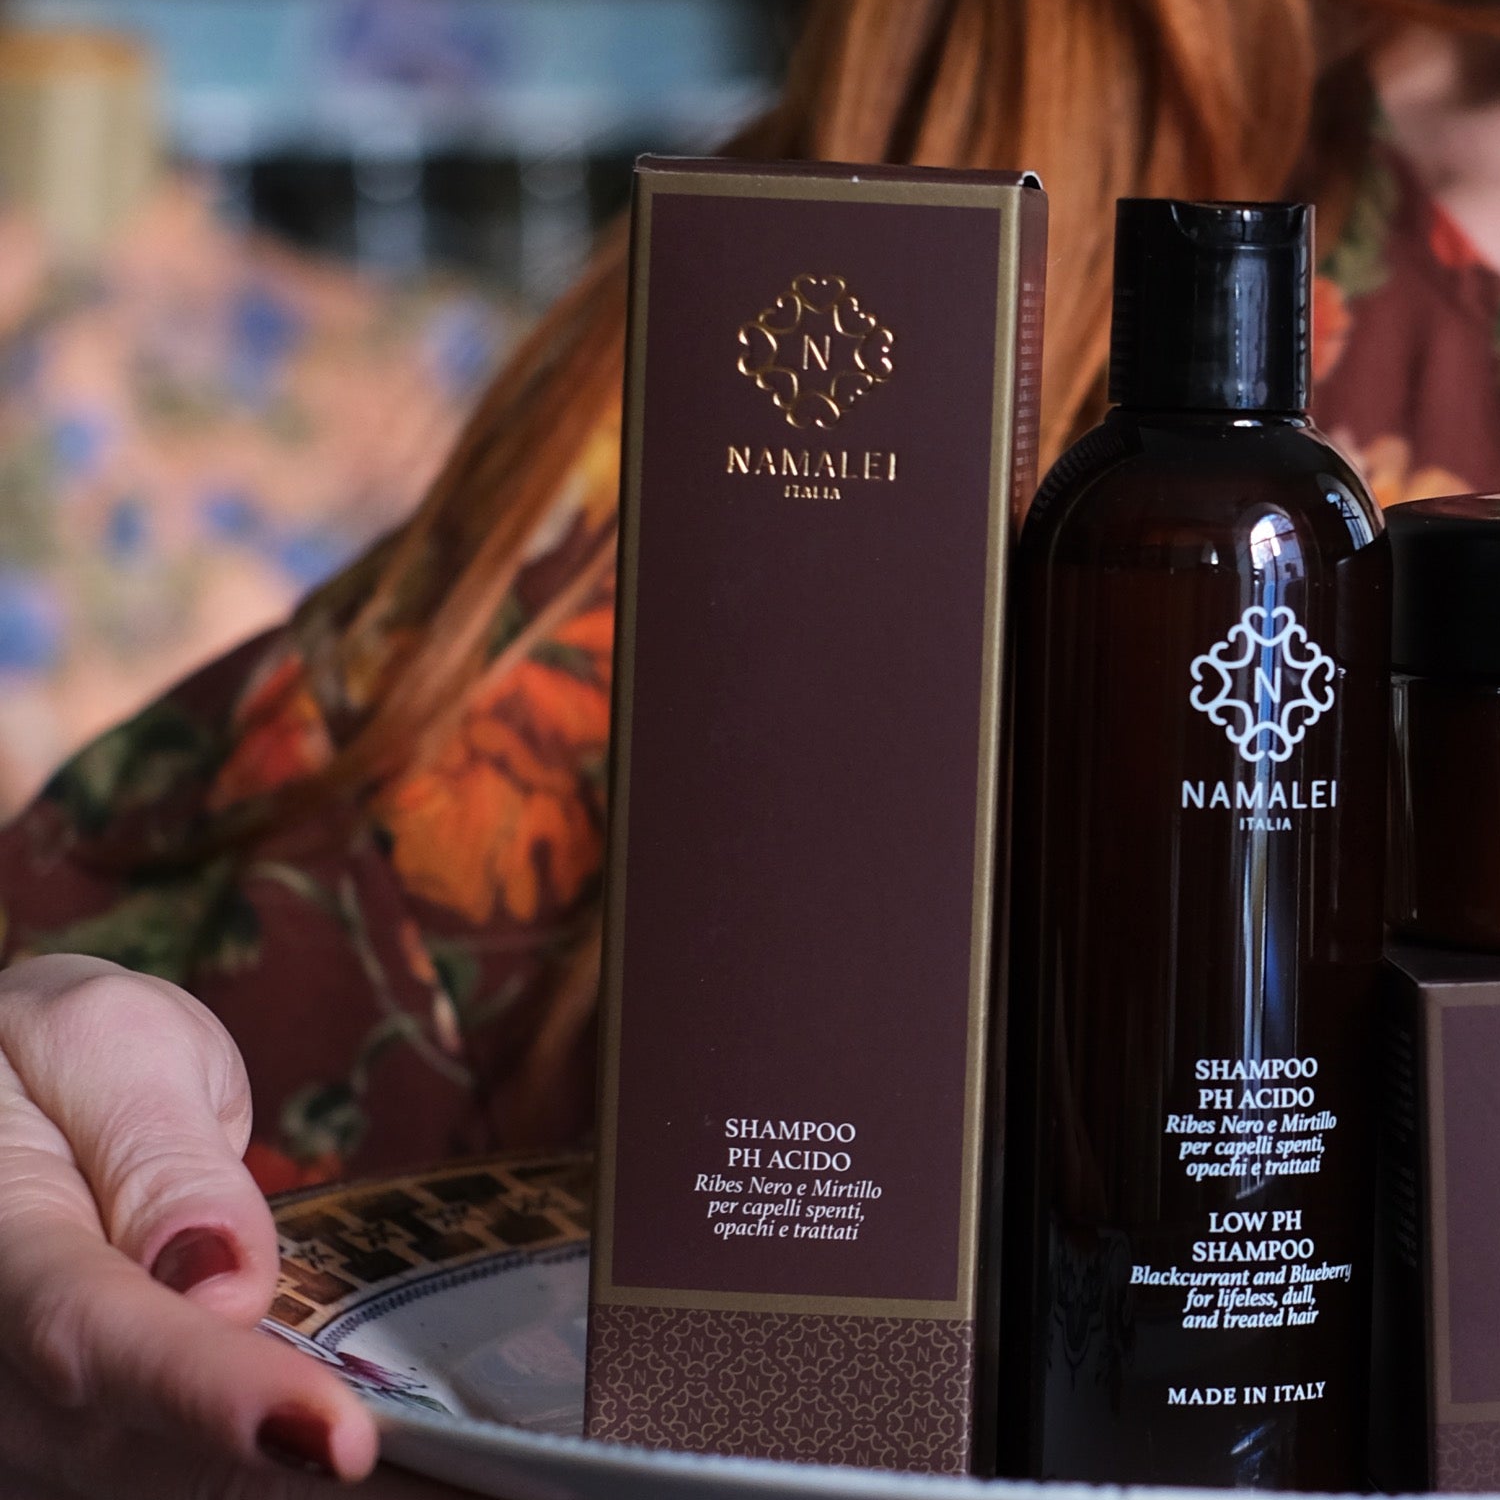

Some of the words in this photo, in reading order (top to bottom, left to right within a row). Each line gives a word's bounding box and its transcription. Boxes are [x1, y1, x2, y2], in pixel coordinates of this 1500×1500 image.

[803, 335, 830, 370] N
[727, 446, 896, 481] NAMALEI
[784, 484, 841, 500] ITALIA
[1254, 666, 1281, 703] N
[1181, 780, 1337, 809] NAMALEI
[1239, 817, 1292, 831] ITALIA
[1194, 1057, 1318, 1080] SHAMPOO
[1198, 1088, 1234, 1109] PH
[1237, 1087, 1315, 1109] ACIDO
[725, 1117, 856, 1143] SHAMPOO
[1165, 1114, 1216, 1134] Ribes
[1219, 1115, 1264, 1134] Nero
[1267, 1119, 1277, 1133] e
[1280, 1110, 1337, 1133] Mirtillo
[727, 1147, 761, 1168] PH
[766, 1150, 852, 1171] ACIDO
[1178, 1140, 1211, 1160] per
[1214, 1135, 1273, 1162] capelli
[1275, 1133, 1325, 1159] spenti,
[1186, 1158, 1247, 1182] opachi
[1251, 1162, 1261, 1176] e
[1265, 1155, 1321, 1175] trattati
[694, 1174, 744, 1193] Ribes
[748, 1176, 792, 1195] Nero
[797, 1183, 807, 1196] e
[811, 1179, 882, 1199] Mirtillo
[707, 1200, 739, 1218] per
[742, 1199, 802, 1221] capelli
[805, 1202, 865, 1222] spenti,
[1208, 1211, 1268, 1233] LOW
[1271, 1210, 1302, 1231] PH
[714, 1218, 775, 1240] opachi
[778, 1224, 789, 1237] e
[794, 1223, 860, 1240] trattati
[1192, 1238, 1315, 1262] SHAMPOO
[1129, 1265, 1250, 1286] Blackcurrant
[1252, 1265, 1287, 1285] and
[1289, 1261, 1352, 1284] Blueberry
[1182, 1287, 1213, 1313] for
[1217, 1288, 1278, 1313] lifeless,
[1281, 1284, 1316, 1305] dull,
[1182, 1309, 1219, 1329] and
[1223, 1308, 1284, 1329] treated
[1287, 1305, 1319, 1326] hair
[691, 1337, 704, 1351] N
[804, 1342, 817, 1357] N
[917, 1346, 930, 1362] N
[634, 1369, 646, 1385] N
[747, 1375, 759, 1390] N
[859, 1379, 872, 1395] N
[1167, 1387, 1236, 1405] MADE
[1243, 1386, 1267, 1404] IN
[1274, 1381, 1326, 1403] ITALY
[688, 1408, 701, 1423] N
[802, 1413, 814, 1428] N
[914, 1417, 927, 1433] N
[857, 1450, 869, 1466] N
